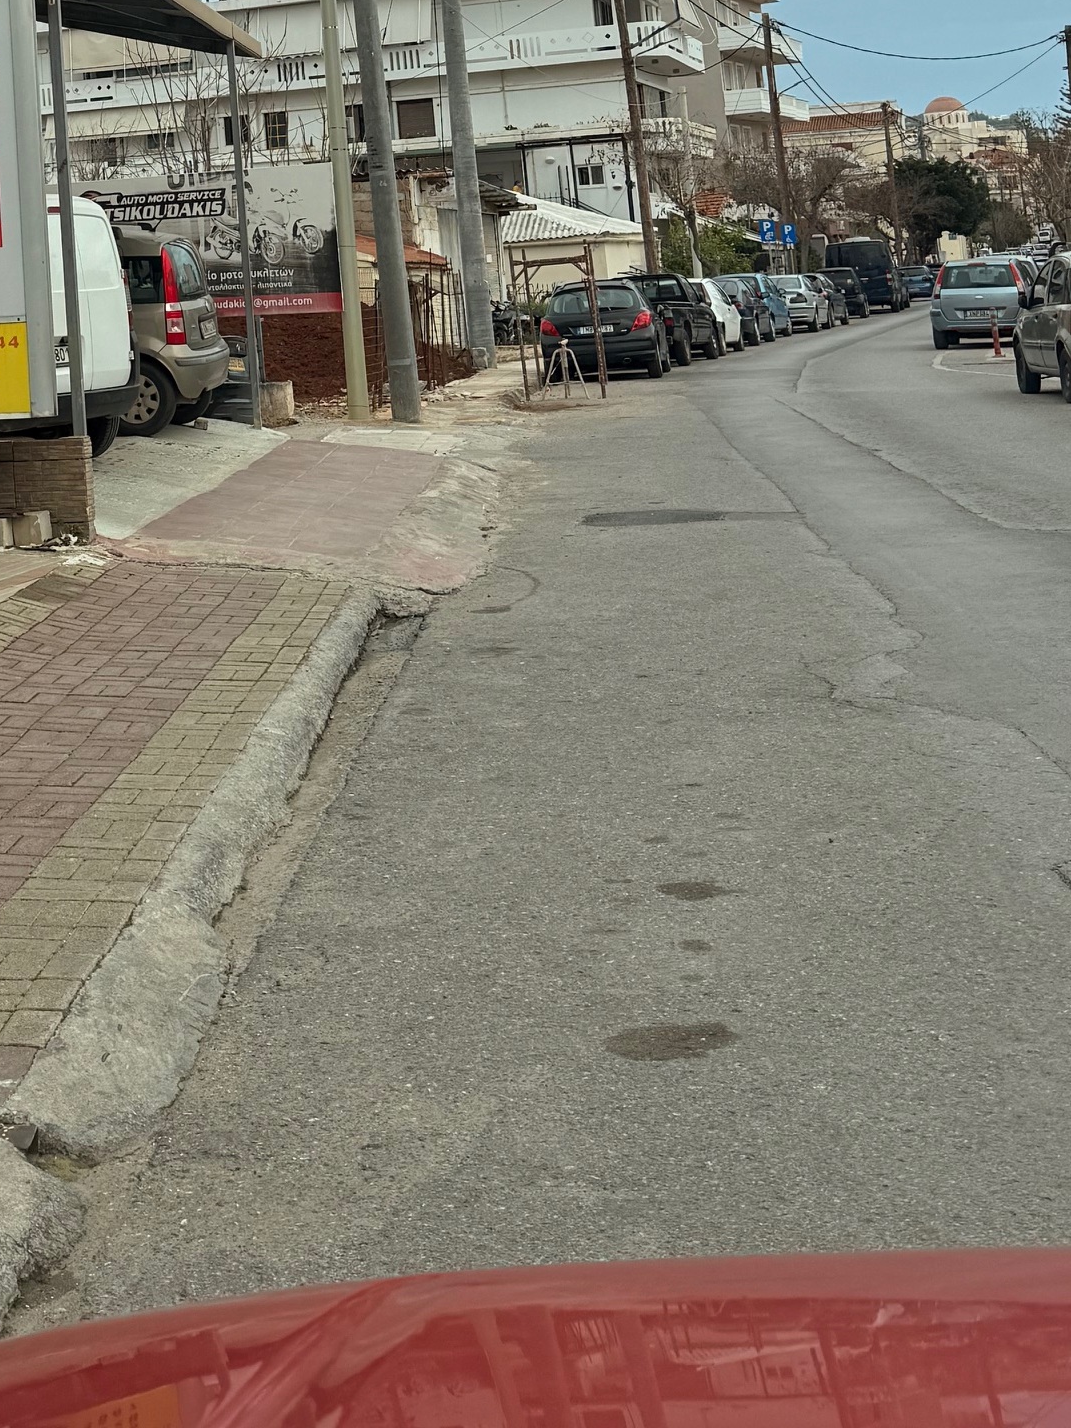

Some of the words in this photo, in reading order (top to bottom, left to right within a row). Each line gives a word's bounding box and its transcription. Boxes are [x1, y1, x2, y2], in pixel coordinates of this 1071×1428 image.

[120, 195, 146, 206] AUTO
[147, 193, 175, 203] MOTO
[177, 190, 222, 201] SERVICE
[762, 221, 771, 232] P
[784, 225, 792, 235] P
